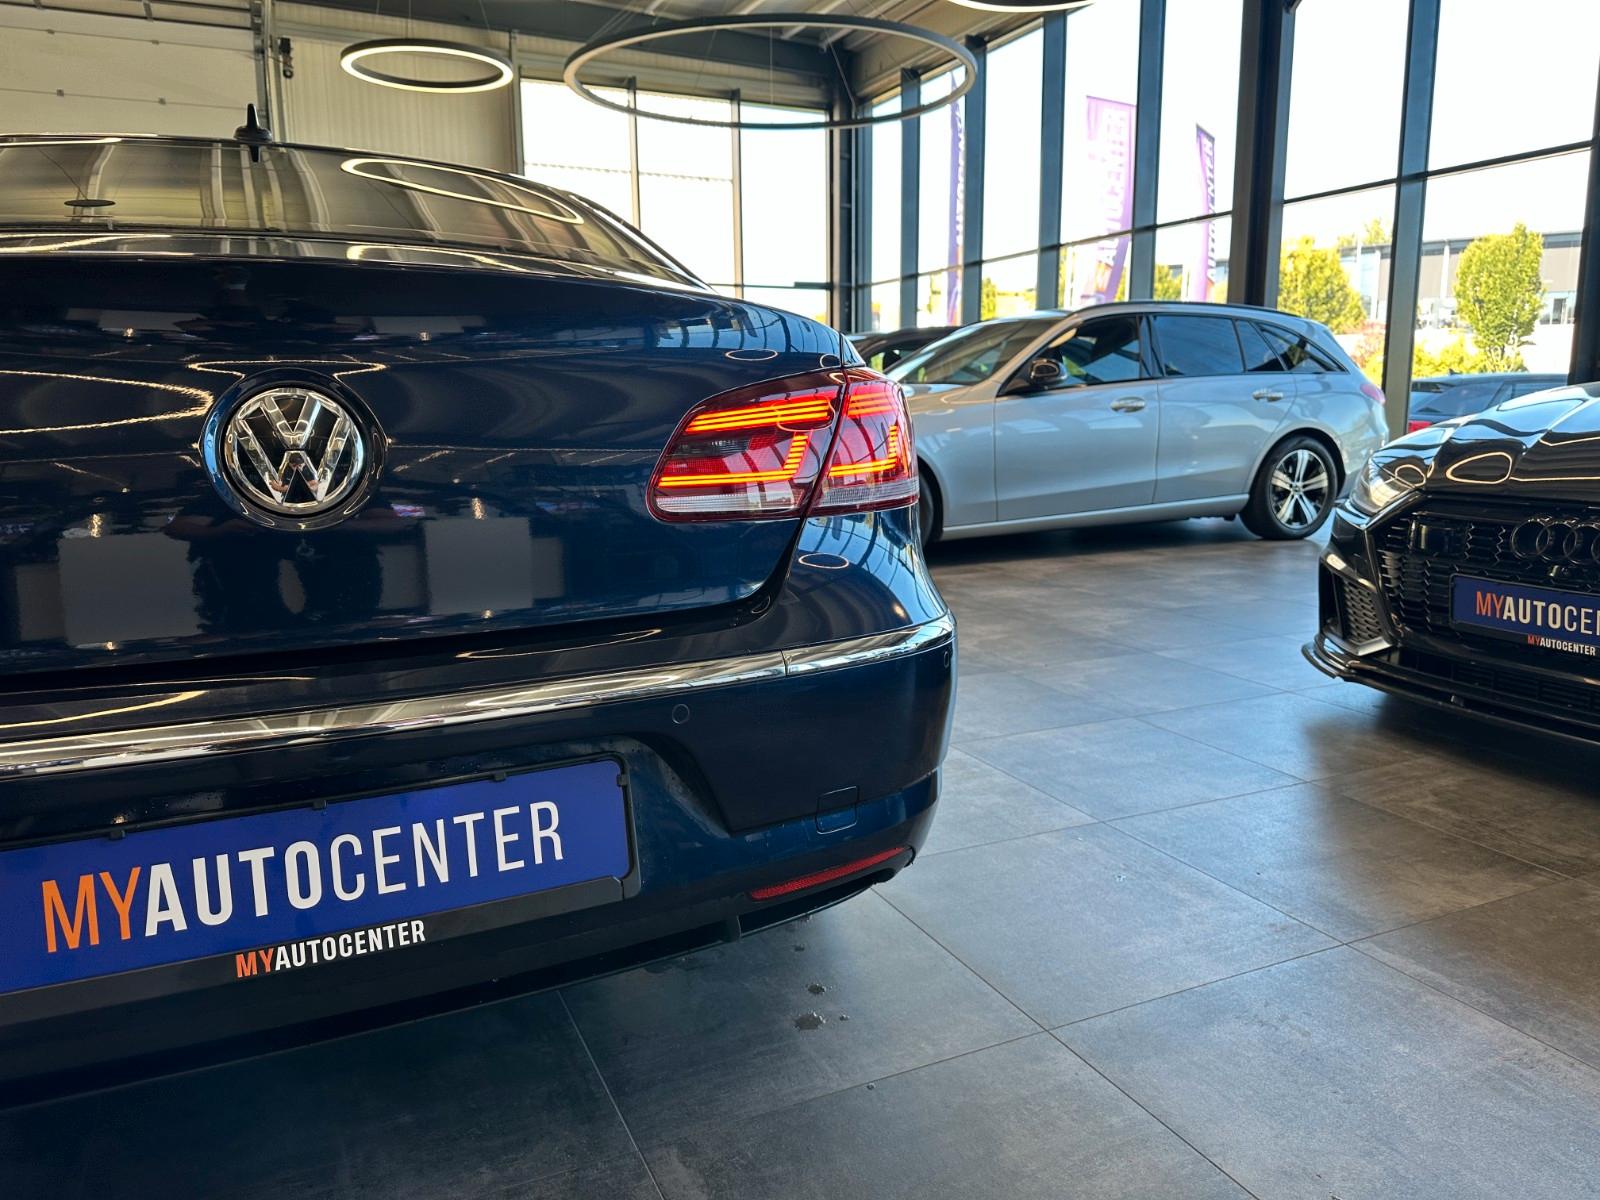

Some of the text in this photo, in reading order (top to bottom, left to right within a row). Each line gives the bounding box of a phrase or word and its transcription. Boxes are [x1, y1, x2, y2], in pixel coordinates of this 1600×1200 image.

[1475, 591, 1600, 635] MYAUTOCE
[1527, 634, 1596, 656] MYAUTOCENTER
[42, 801, 563, 953] MYAUTOCENTER
[236, 920, 426, 978] MYAUTOCENTER
